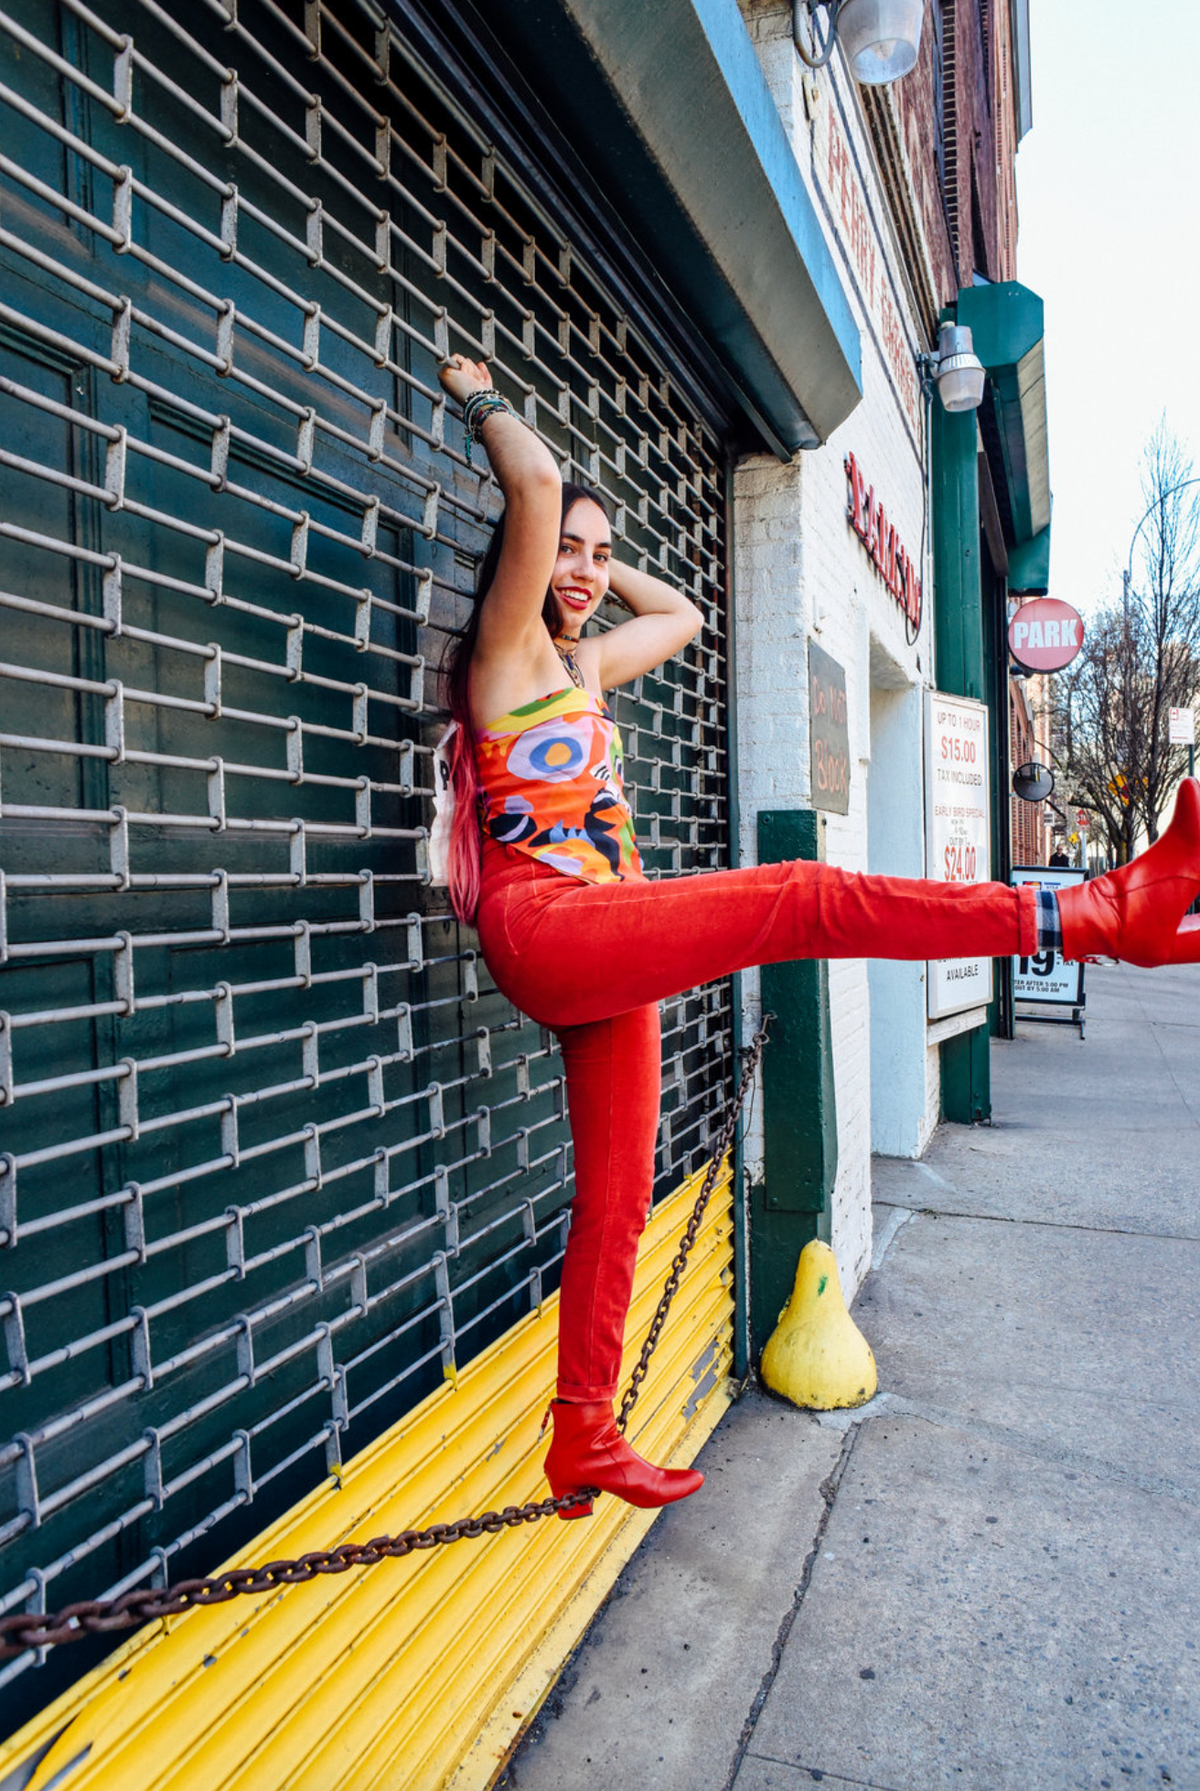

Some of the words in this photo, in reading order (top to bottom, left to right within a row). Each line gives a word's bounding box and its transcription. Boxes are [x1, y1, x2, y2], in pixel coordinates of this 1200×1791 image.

[1014, 619, 1078, 649] PARK
[937, 711, 946, 725] UP
[948, 713, 956, 727] TO
[963, 717, 980, 731] HOUR
[941, 736, 976, 763] $15.00
[937, 768, 950, 782] TAX
[950, 770, 982, 786] INCLUDED
[935, 805, 951, 817] EARLY
[944, 845, 976, 881] $24.00
[947, 964, 978, 981] AVAILABLE
